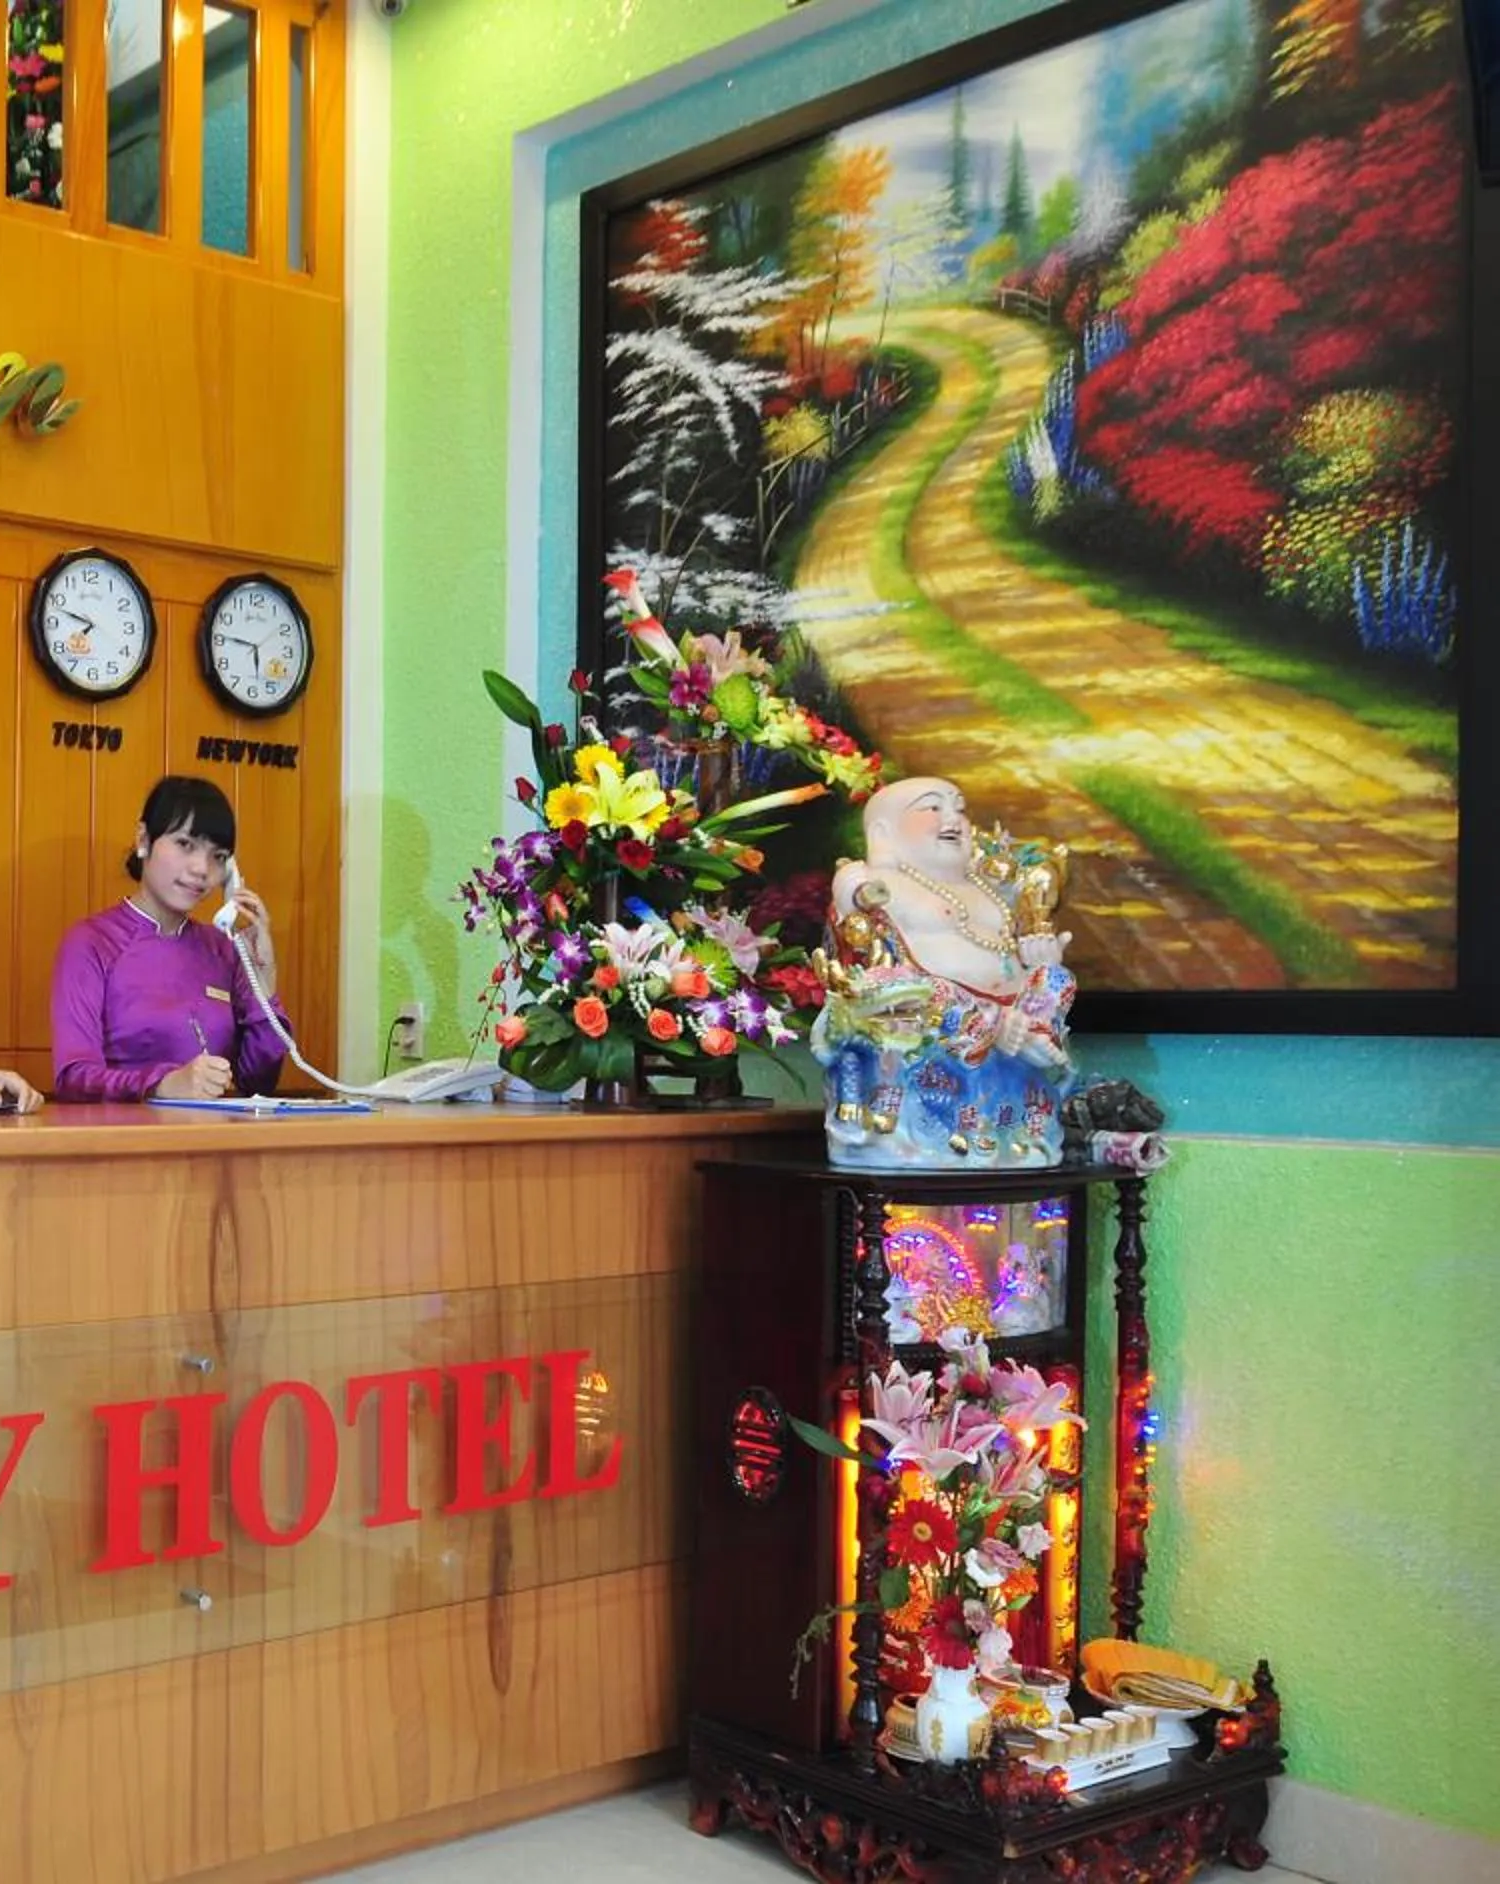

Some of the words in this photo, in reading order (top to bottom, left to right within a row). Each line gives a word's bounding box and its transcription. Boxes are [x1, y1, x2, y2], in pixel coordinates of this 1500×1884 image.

[66, 576, 76, 589] 11
[83, 570, 98, 584] 12
[118, 598, 130, 612] 2
[124, 622, 134, 635] 3
[54, 641, 64, 654] 8
[120, 645, 129, 657] 4
[68, 660, 78, 672] 7
[106, 662, 118, 674] 5
[88, 668, 98, 680] 6
[52, 721, 122, 752] TOKYO
[94, 1350, 624, 1575] HOTEL
